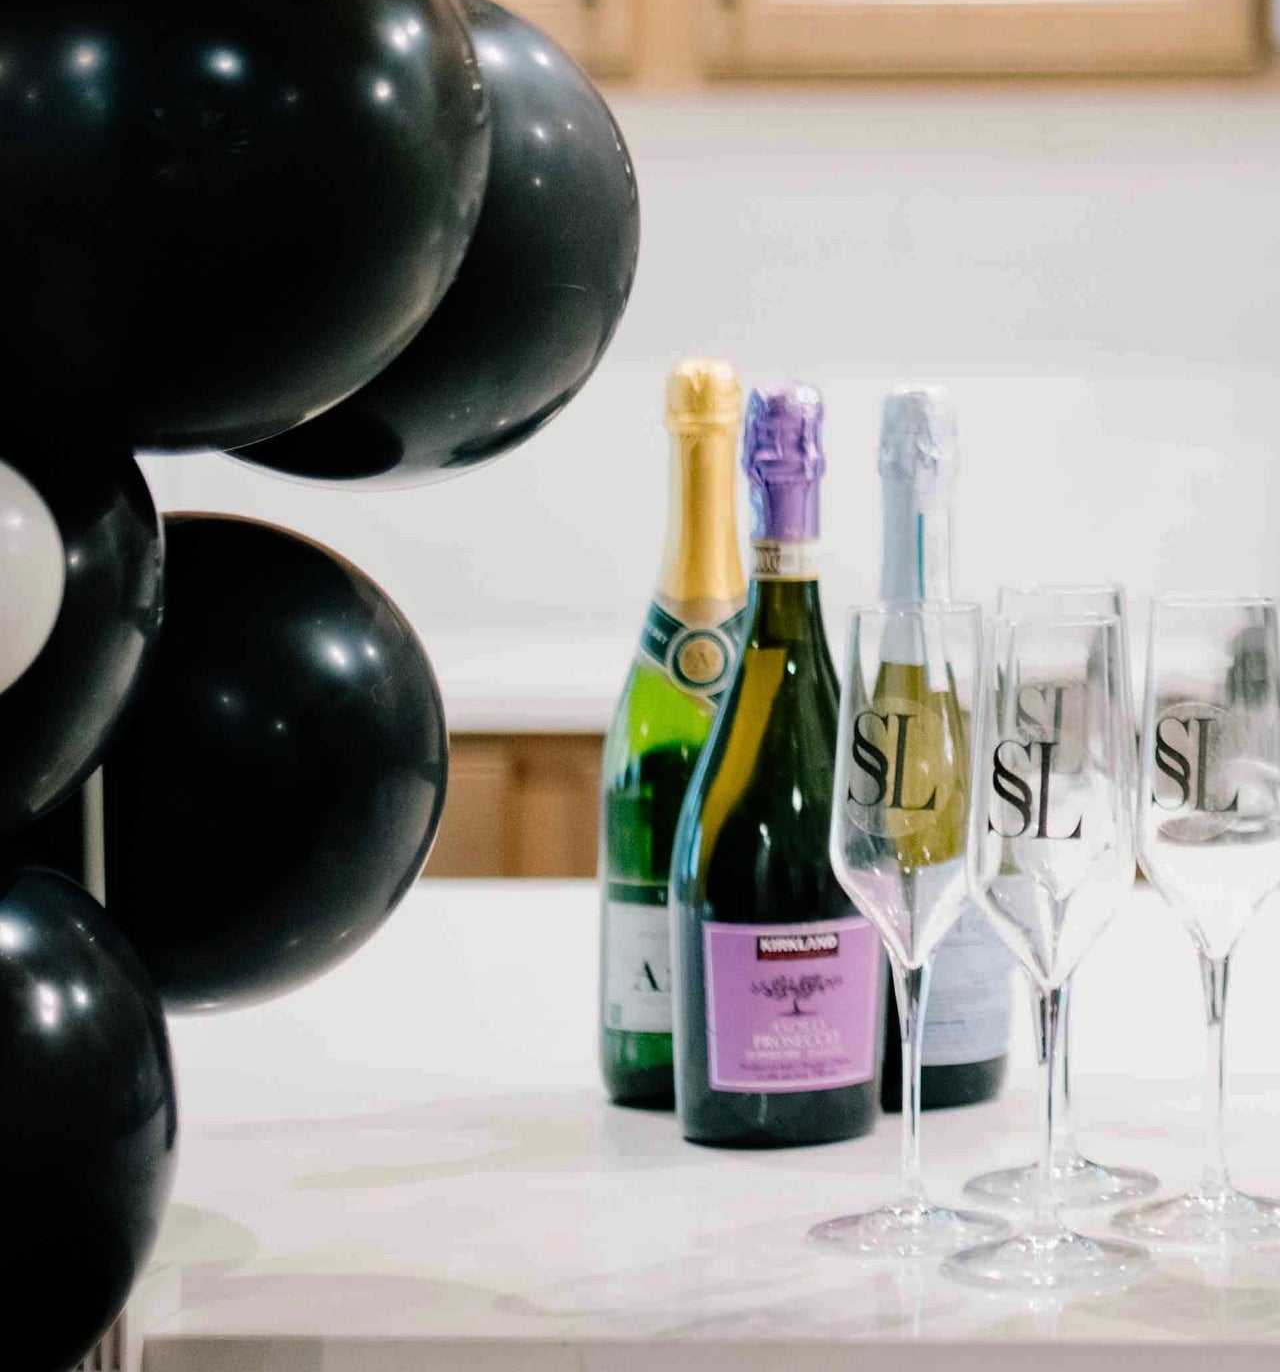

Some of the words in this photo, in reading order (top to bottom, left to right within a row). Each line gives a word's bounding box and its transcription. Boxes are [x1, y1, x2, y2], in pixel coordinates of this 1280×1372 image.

[847, 710, 937, 810] SL
[988, 739, 1082, 839] SL
[1151, 716, 1239, 812] SL
[759, 935, 839, 953] KIRKLAND
